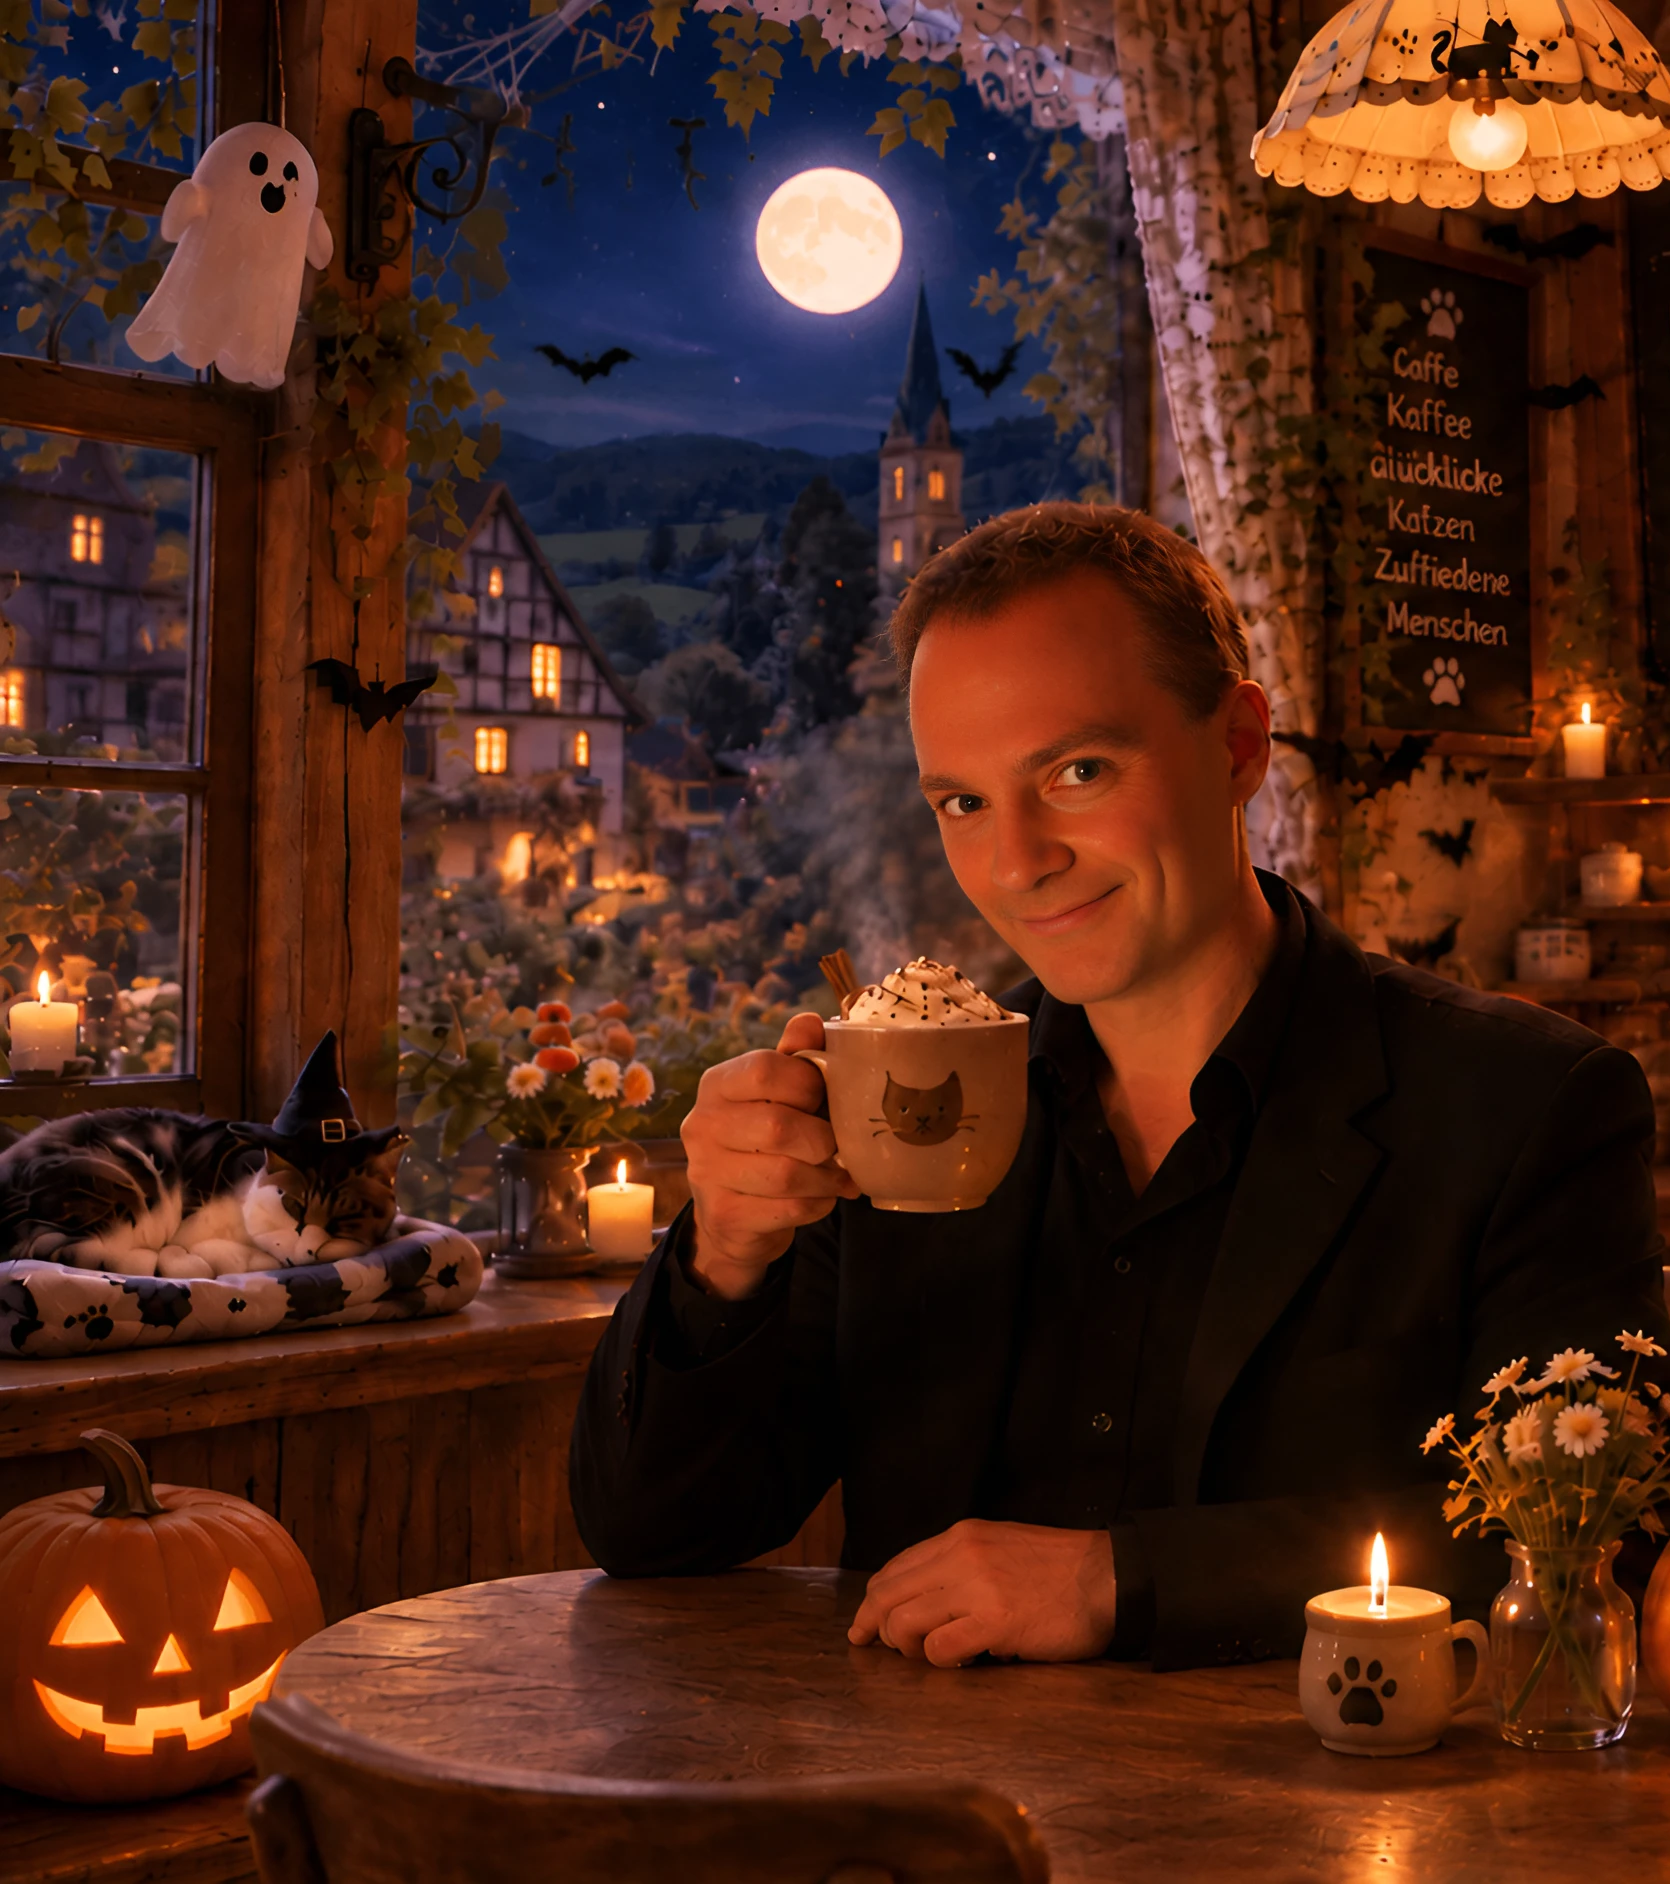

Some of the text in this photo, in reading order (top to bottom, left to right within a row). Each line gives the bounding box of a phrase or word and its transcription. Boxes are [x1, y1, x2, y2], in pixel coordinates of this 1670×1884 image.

[1393, 347, 1460, 389] Caffe
[1387, 392, 1472, 440] Kaffee
[1387, 496, 1476, 543] Katzen
[1387, 601, 1508, 646] Menschen
